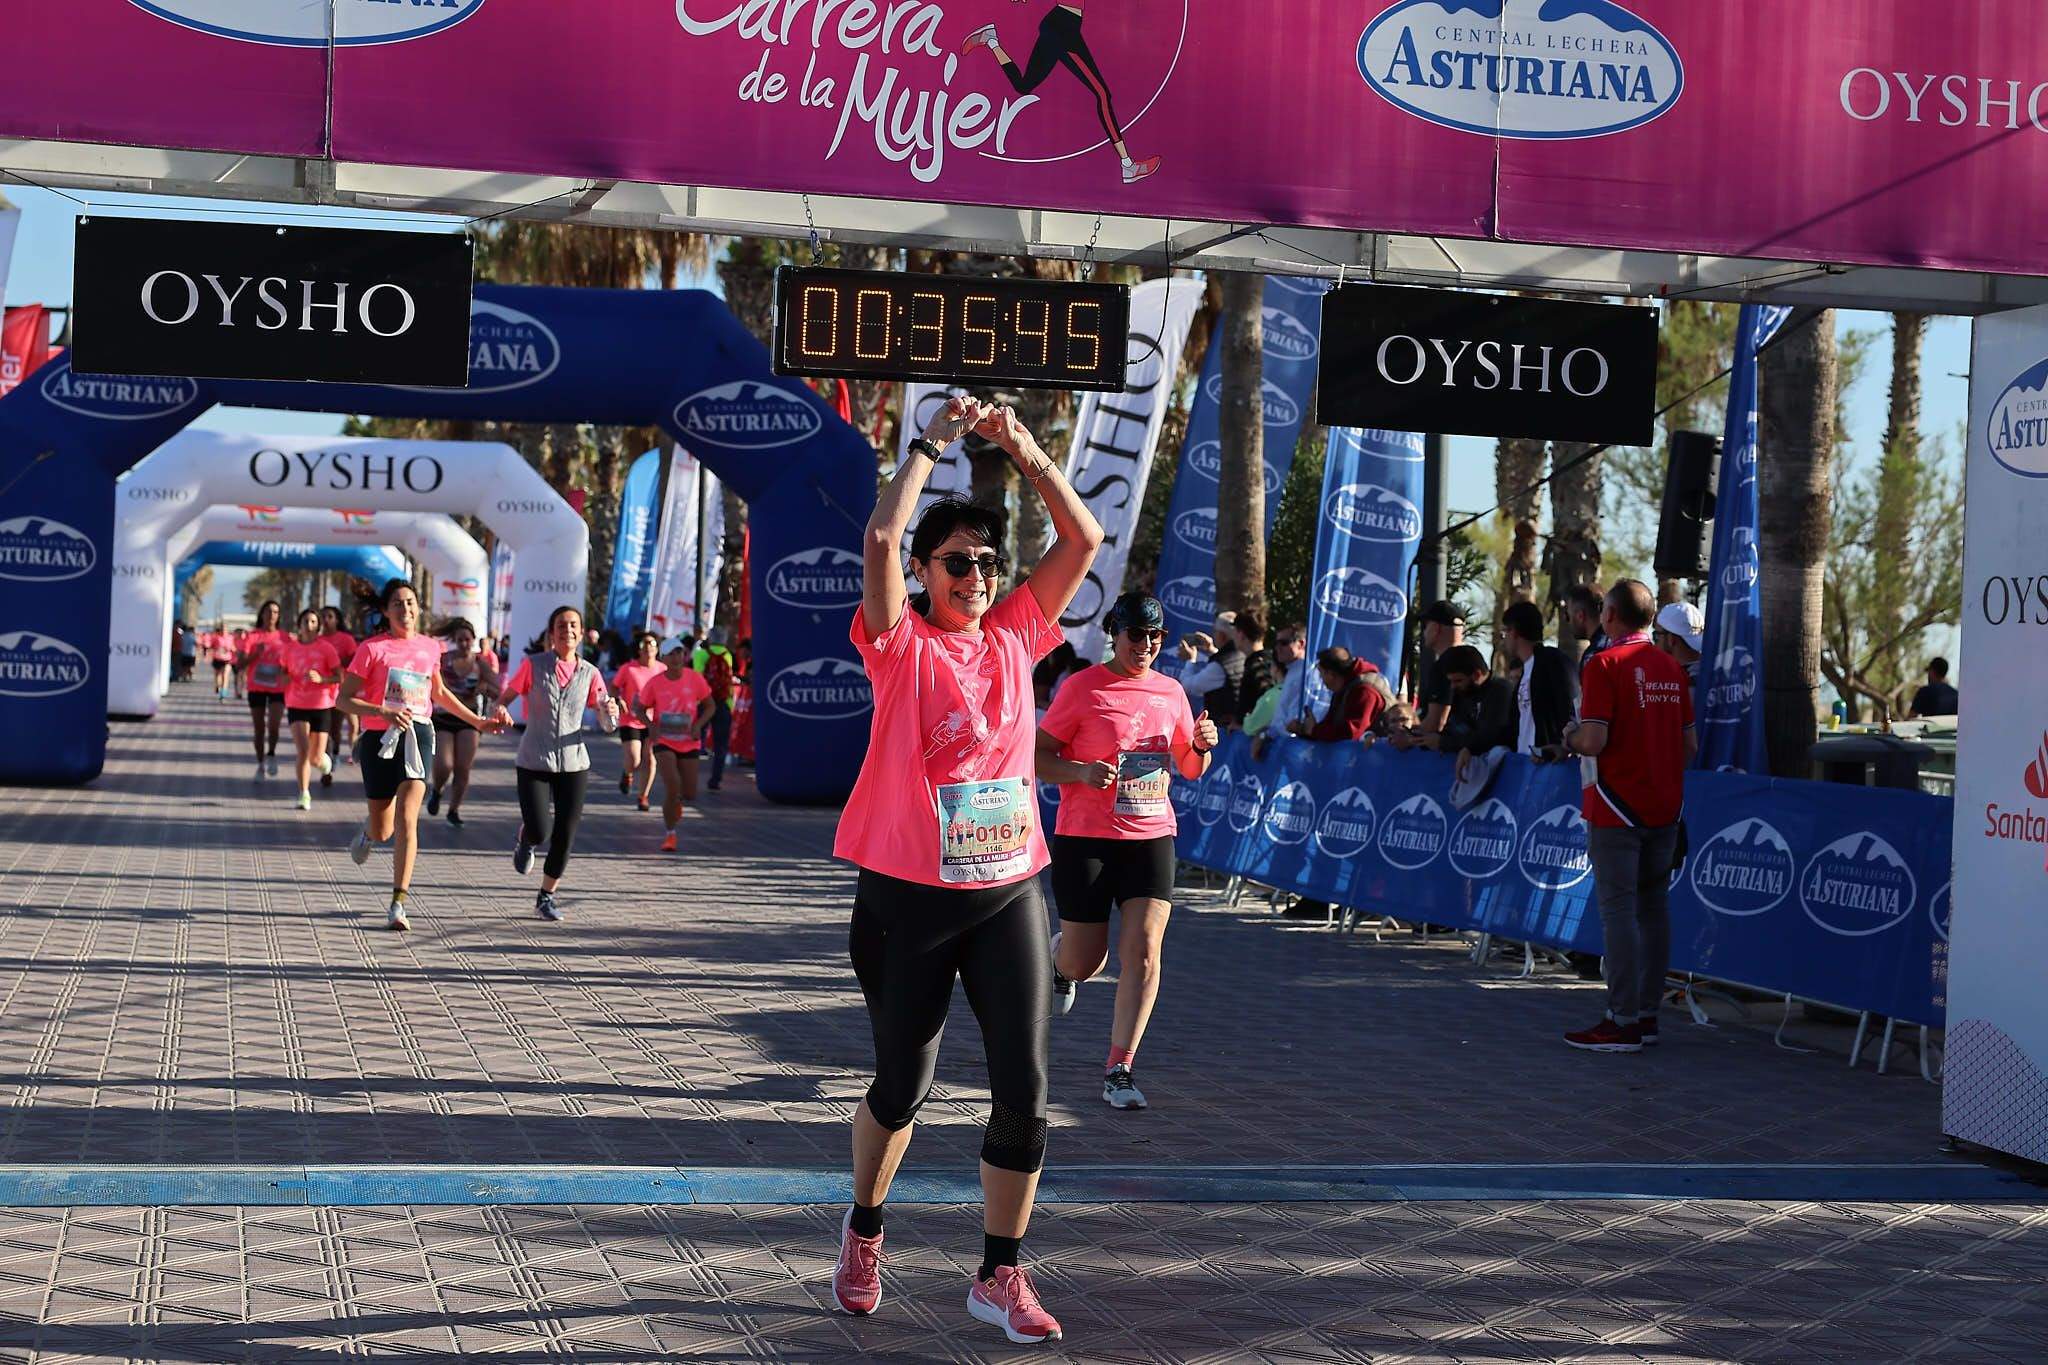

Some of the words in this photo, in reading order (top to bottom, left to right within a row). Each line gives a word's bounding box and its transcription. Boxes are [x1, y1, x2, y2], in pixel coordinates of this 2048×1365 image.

[675, 0, 942, 56] Carrera
[1435, 26, 1535, 47] CENTRAL
[1547, 34, 1649, 56] LECHERA
[1382, 25, 1658, 104] ASTURIANA
[738, 48, 788, 102] de
[800, 50, 835, 108] la
[825, 53, 1040, 182] Mujer
[141, 270, 416, 337] OYSHO
[1376, 335, 1609, 397] OYSHO
[52, 369, 185, 405] ASTURIANA
[688, 405, 812, 431] ASTURIANA
[249, 449, 443, 494] OYSHO
[129, 488, 189, 503] OYSHO
[497, 501, 555, 513] OYSHO
[1331, 496, 1416, 537] ASTURIANA
[525, 579, 578, 593] OYSHO
[1319, 583, 1400, 618] ASTURIANA
[976, 823, 1012, 842] 016
[1321, 810, 1369, 842] ASTURIANA
[1382, 818, 1440, 852] ASTURIANA
[1452, 826, 1511, 860] ASTURIANA
[1523, 833, 1588, 871] ASTURIANA
[1697, 850, 1784, 895] ASTURIANA
[1806, 864, 1900, 915] ASTURIANA
